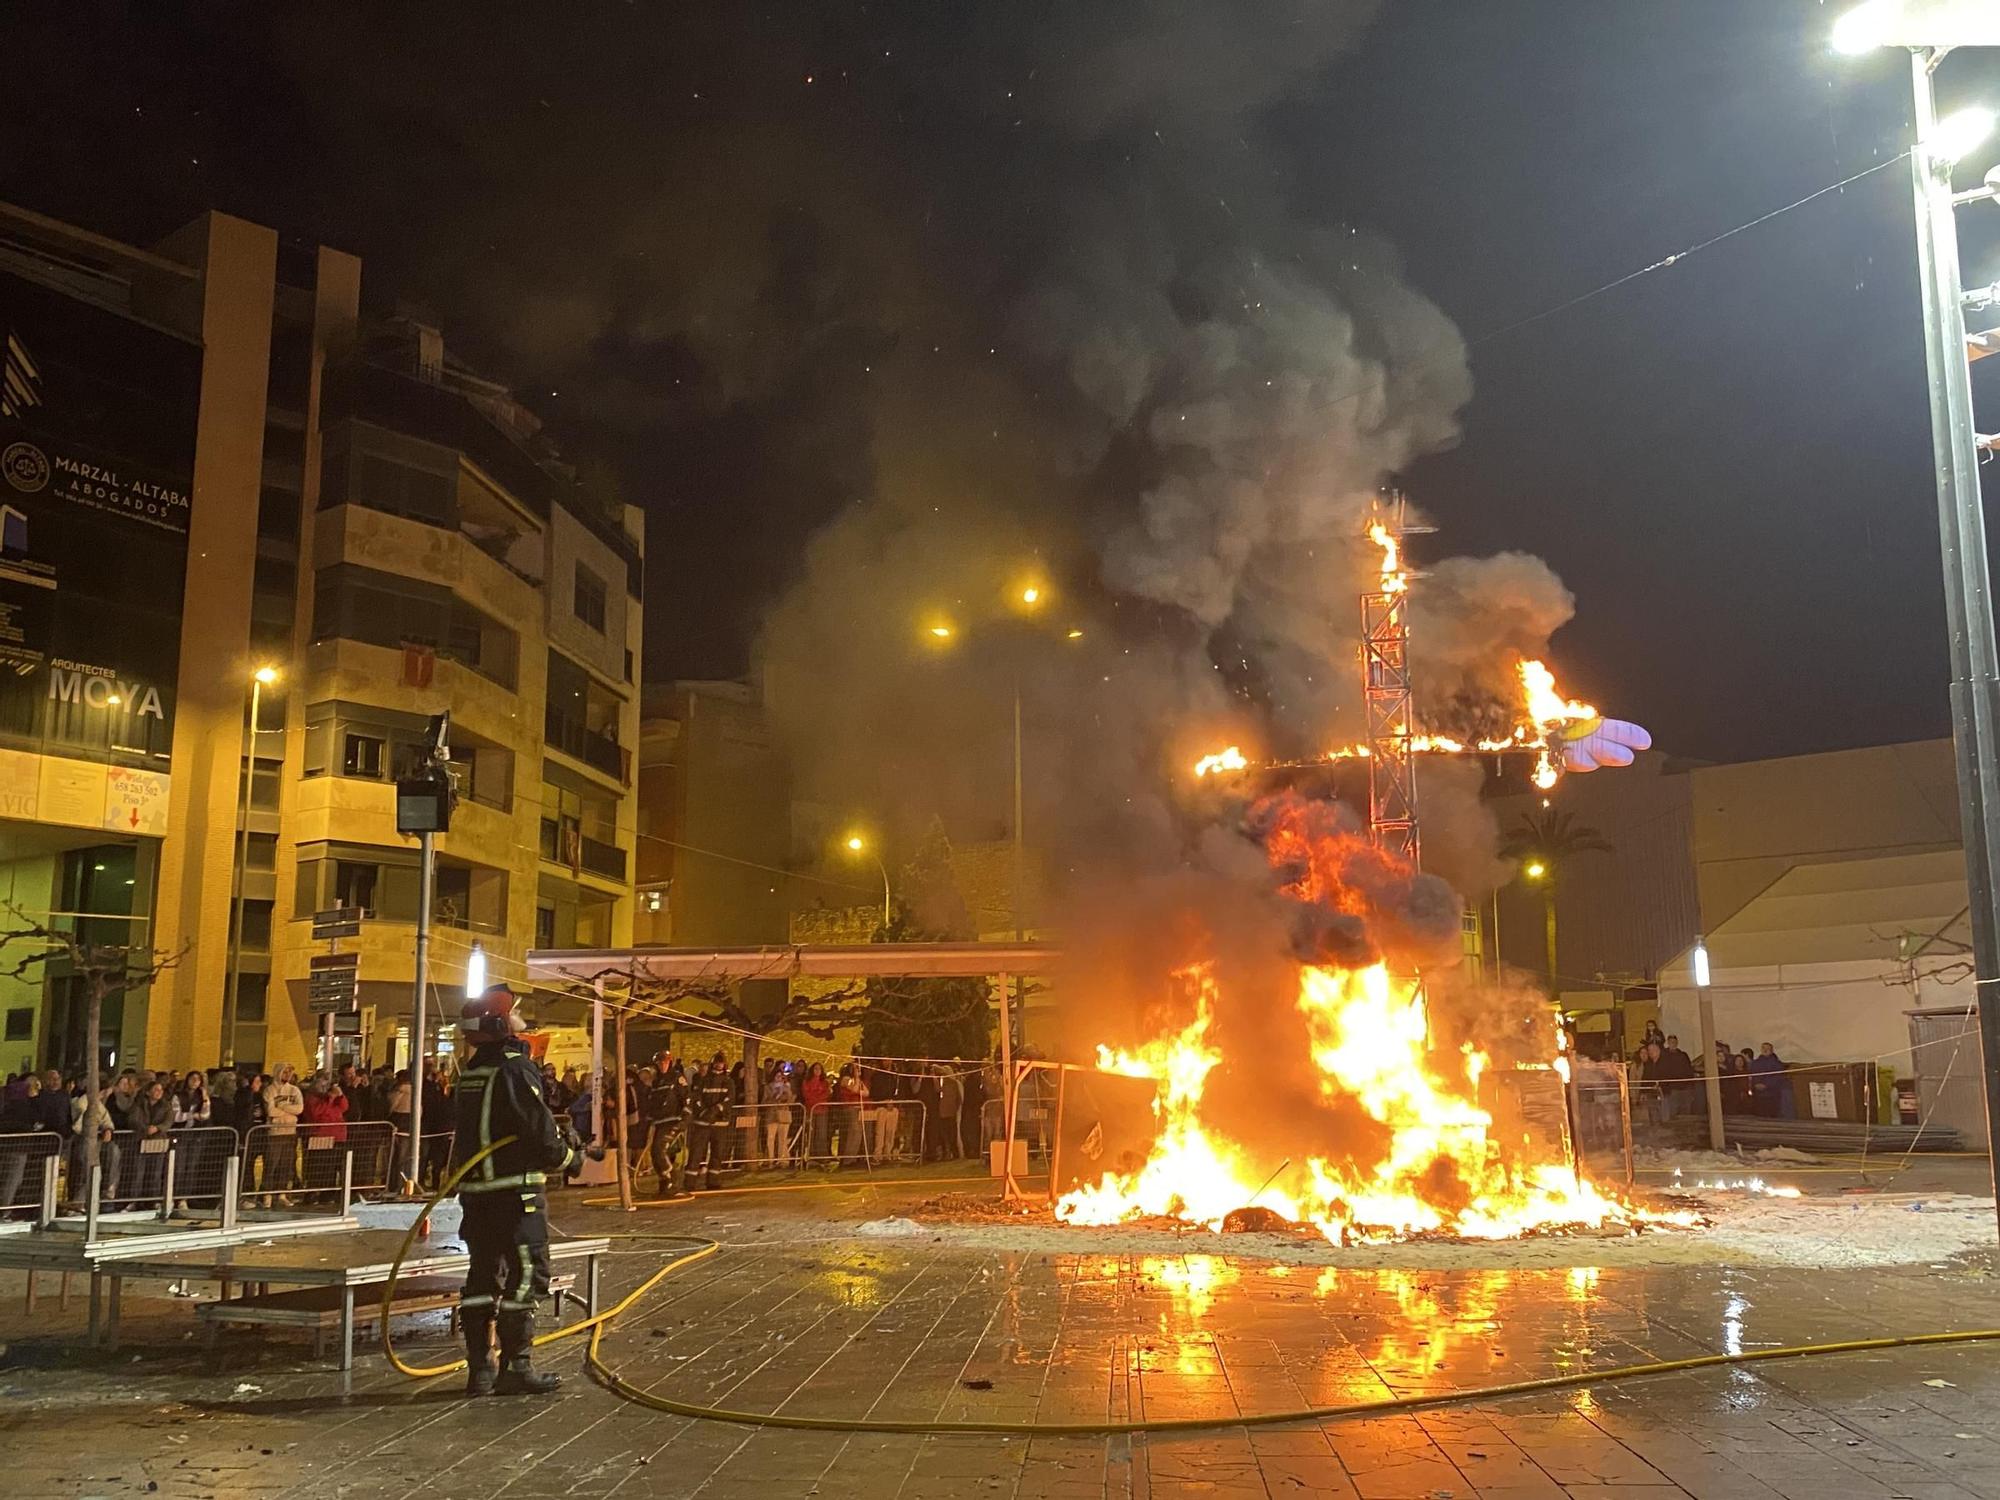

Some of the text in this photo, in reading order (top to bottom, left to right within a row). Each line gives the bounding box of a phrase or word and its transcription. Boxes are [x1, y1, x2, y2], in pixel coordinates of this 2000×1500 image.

[55, 456, 119, 487] MARZAL
[132, 480, 189, 508] ALTABA
[70, 480, 168, 517] ABOGADOS
[50, 657, 116, 679] ARQUITECTES
[48, 668, 164, 720] MOYA
